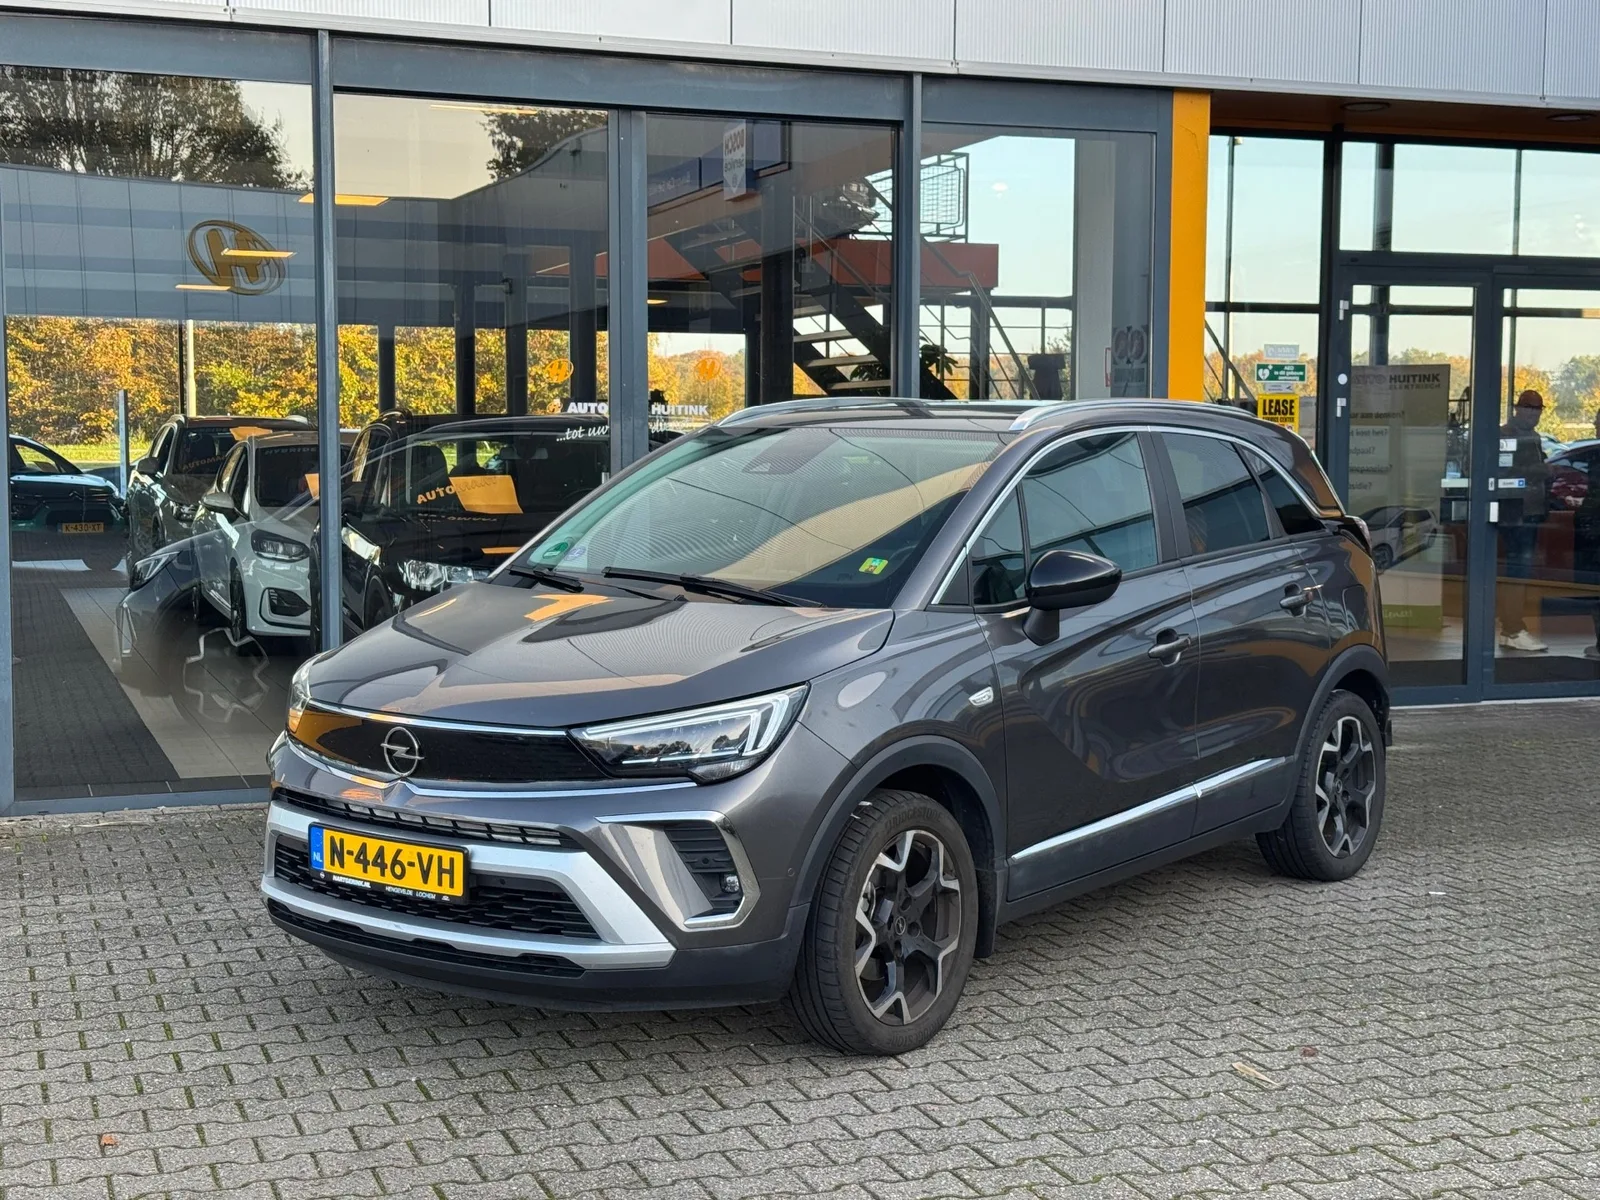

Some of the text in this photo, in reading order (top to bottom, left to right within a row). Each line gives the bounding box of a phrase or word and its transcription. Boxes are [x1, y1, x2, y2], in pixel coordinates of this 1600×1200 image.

[1389, 373, 1440, 384] HUITINK
[567, 402, 709, 416] AUTO HUITINK
[1262, 399, 1295, 416] LEASE
[64, 524, 101, 532] K-430-XT
[313, 851, 323, 863] NL
[329, 835, 455, 889] N-446-VH
[415, 891, 437, 900] LOCHEM
